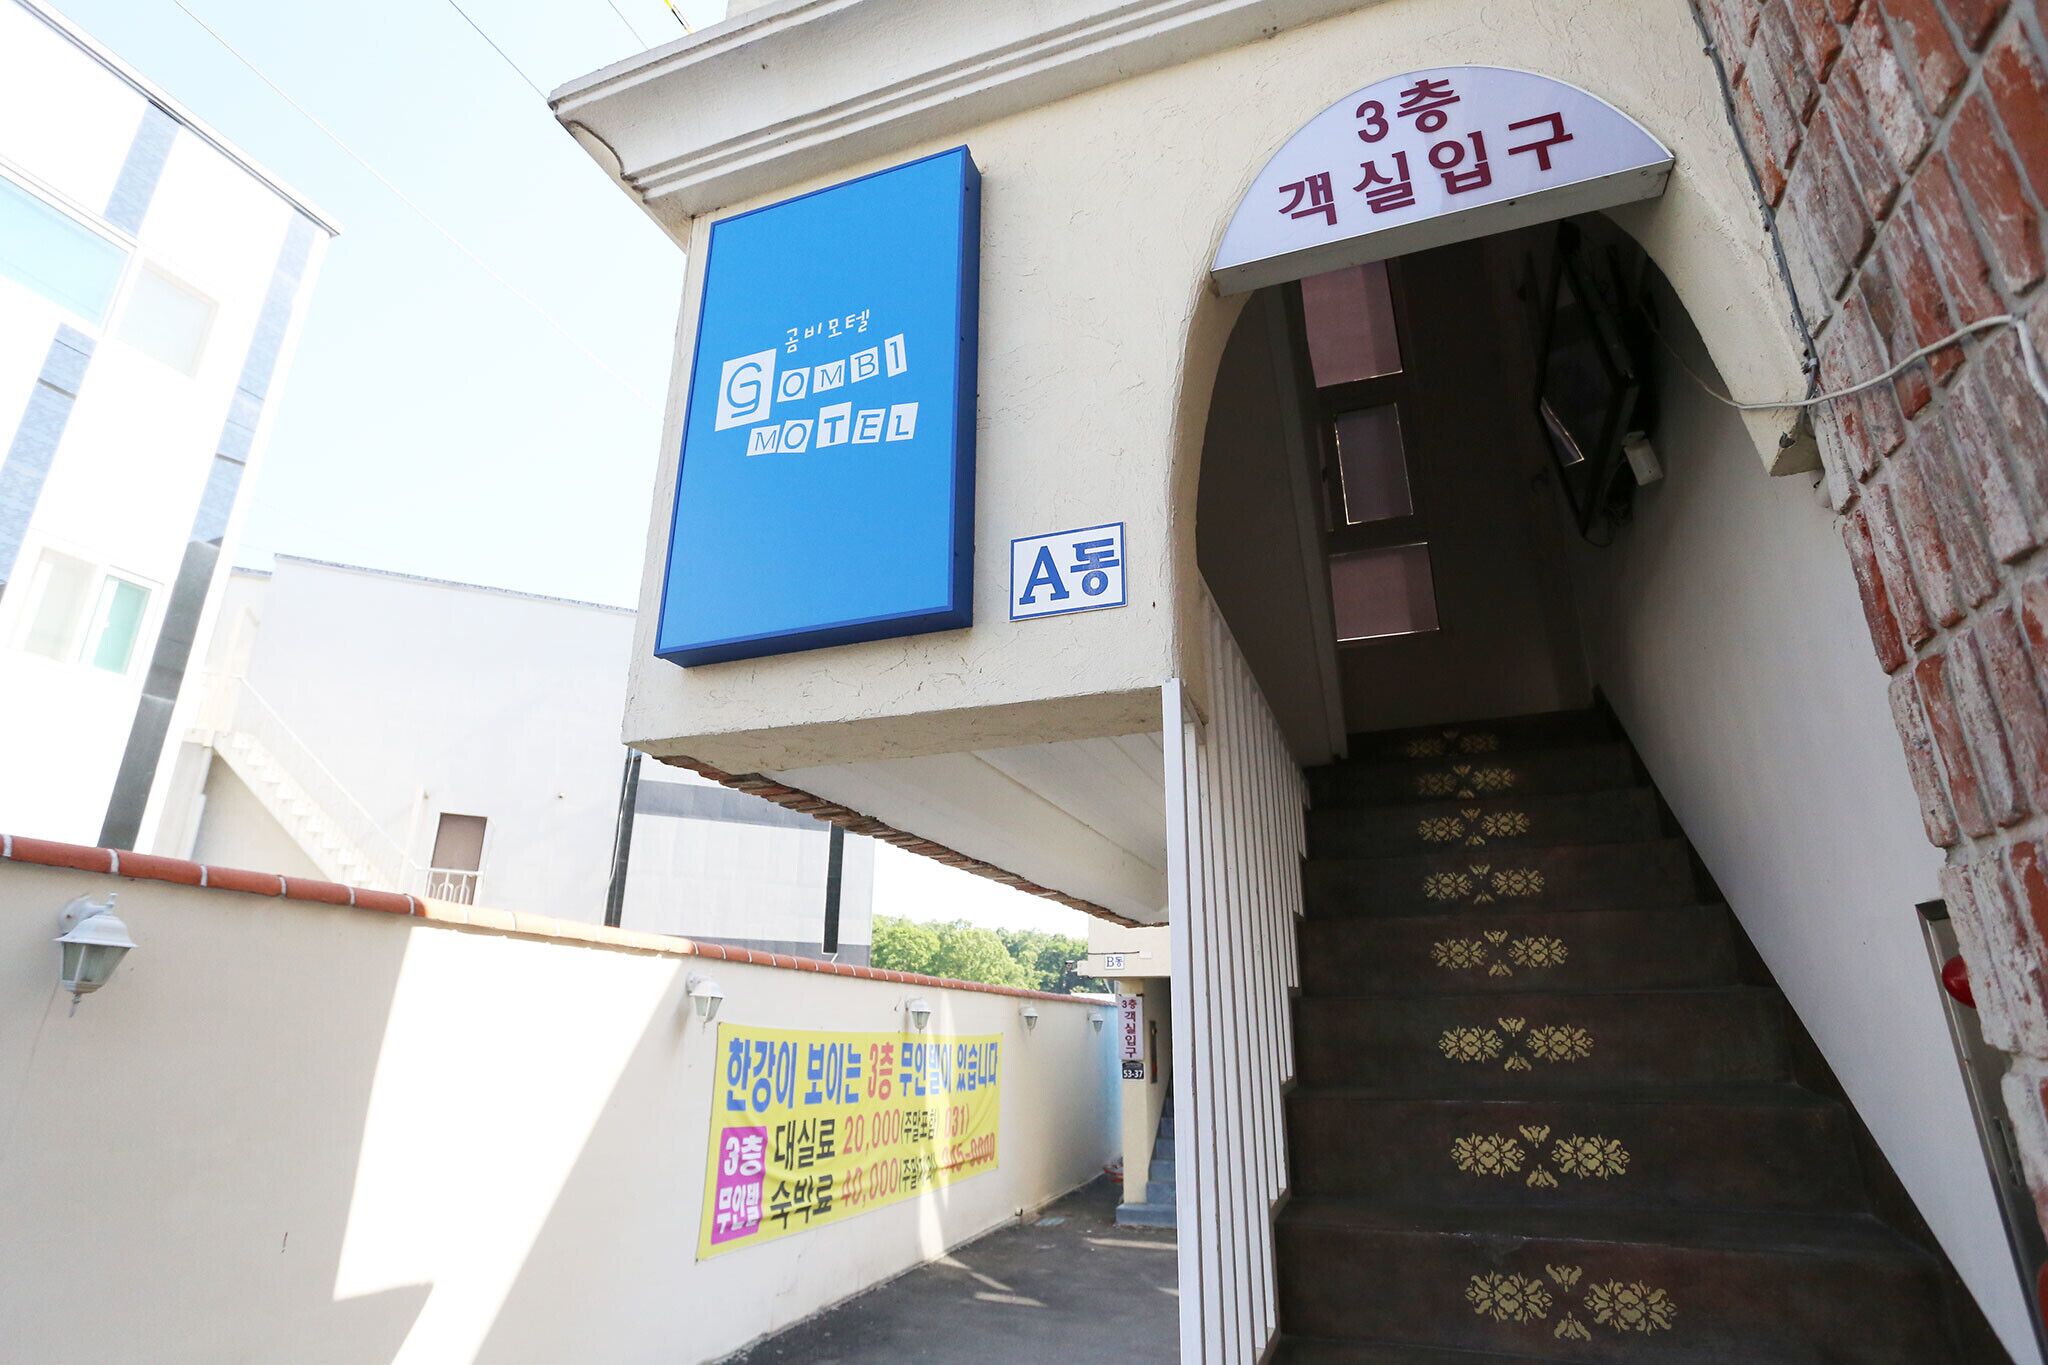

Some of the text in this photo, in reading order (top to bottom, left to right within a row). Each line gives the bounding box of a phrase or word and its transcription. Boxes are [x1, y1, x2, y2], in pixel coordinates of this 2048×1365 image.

[1356, 78, 1461, 143] 3층
[1278, 112, 1574, 226] 객실입구
[785, 309, 870, 354] 곰비모텔
[722, 336, 904, 425] GOMBI
[751, 409, 914, 453] MOTEL
[1019, 538, 1120, 605] A동
[1106, 956, 1124, 968] B동
[1121, 999, 1138, 1009] 3층
[1124, 1011, 1138, 1059] 객실입구
[726, 1037, 798, 1113] 한강이
[804, 1043, 862, 1105] 보이는
[867, 1041, 895, 1101] 3층
[956, 1042, 999, 1093] 있습니다
[1122, 1069, 1144, 1079] 53-37
[723, 1134, 764, 1177] 3층
[774, 1117, 836, 1171] 대실료
[842, 1108, 900, 1156] 20,000
[770, 1173, 834, 1230] 숙박료
[840, 1157, 899, 1208] 40,000
